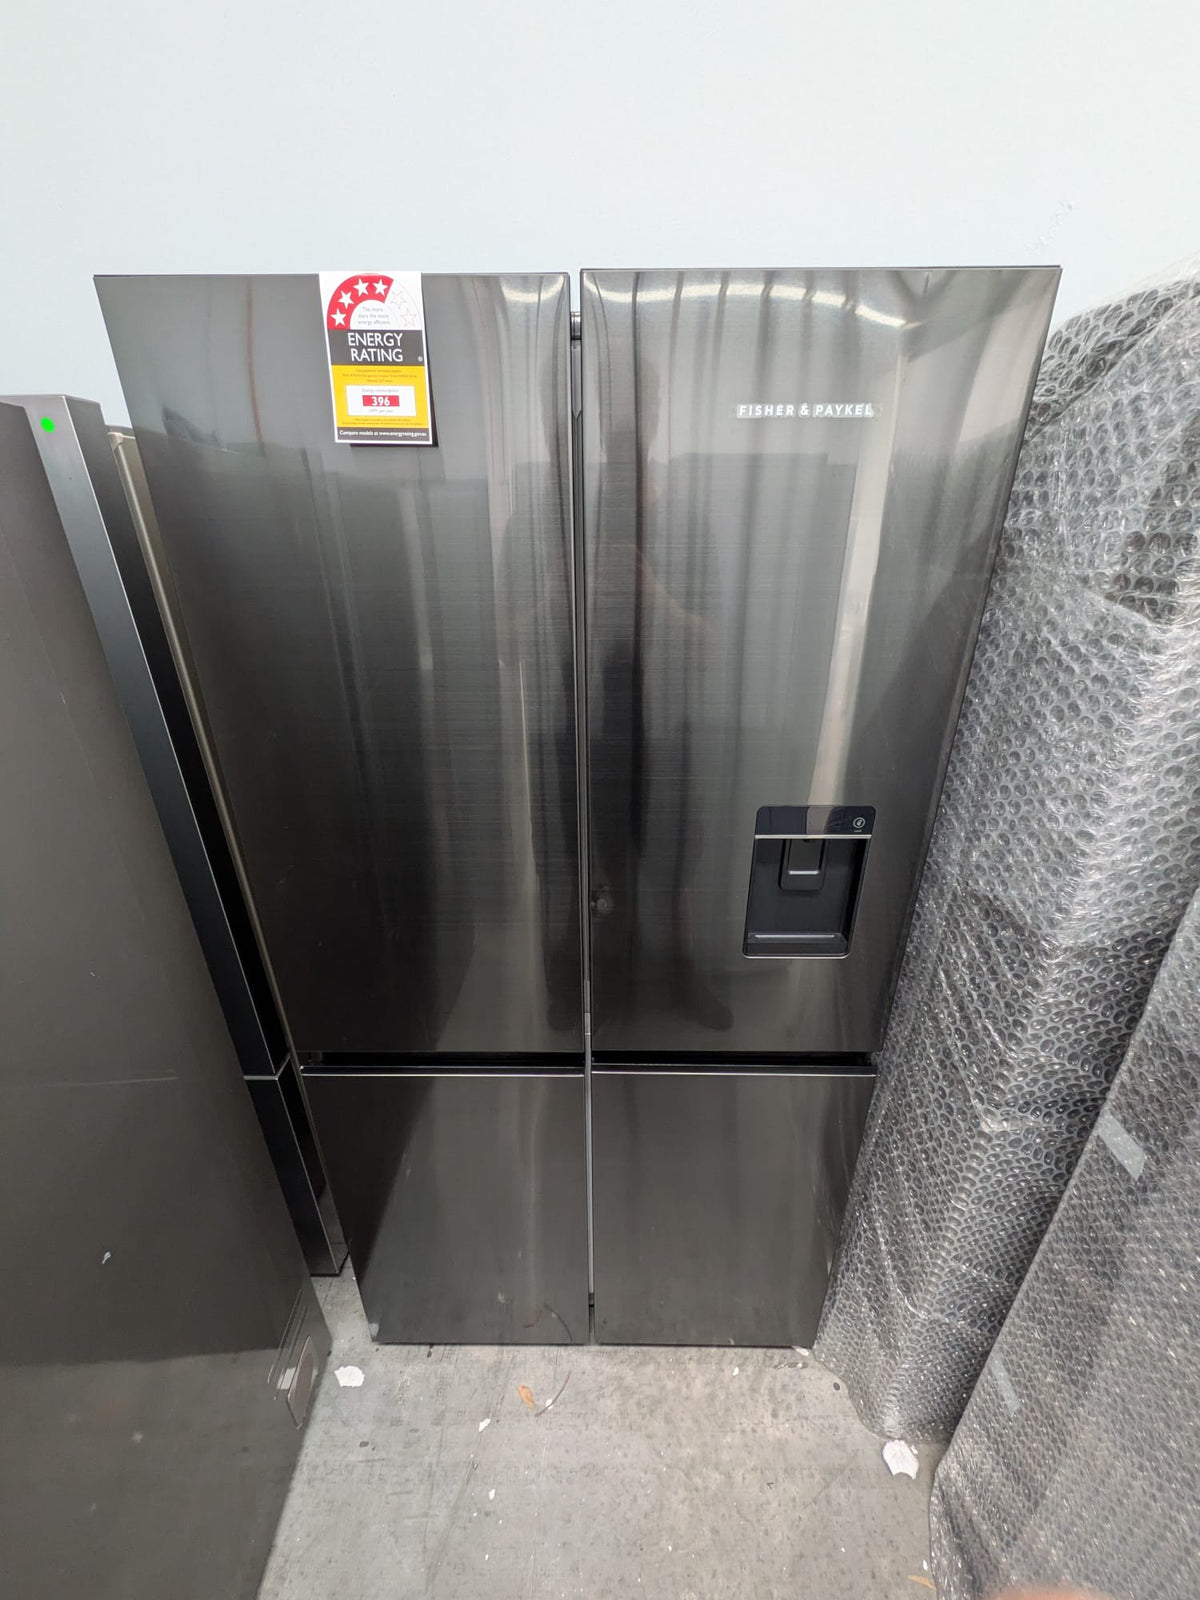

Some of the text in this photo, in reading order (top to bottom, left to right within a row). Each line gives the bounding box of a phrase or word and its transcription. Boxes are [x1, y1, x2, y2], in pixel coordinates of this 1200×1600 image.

[347, 332, 403, 347] ENERGY
[350, 348, 403, 362] RATING
[371, 396, 390, 406] 396
[739, 403, 874, 416] FISHER & PAYKEL
